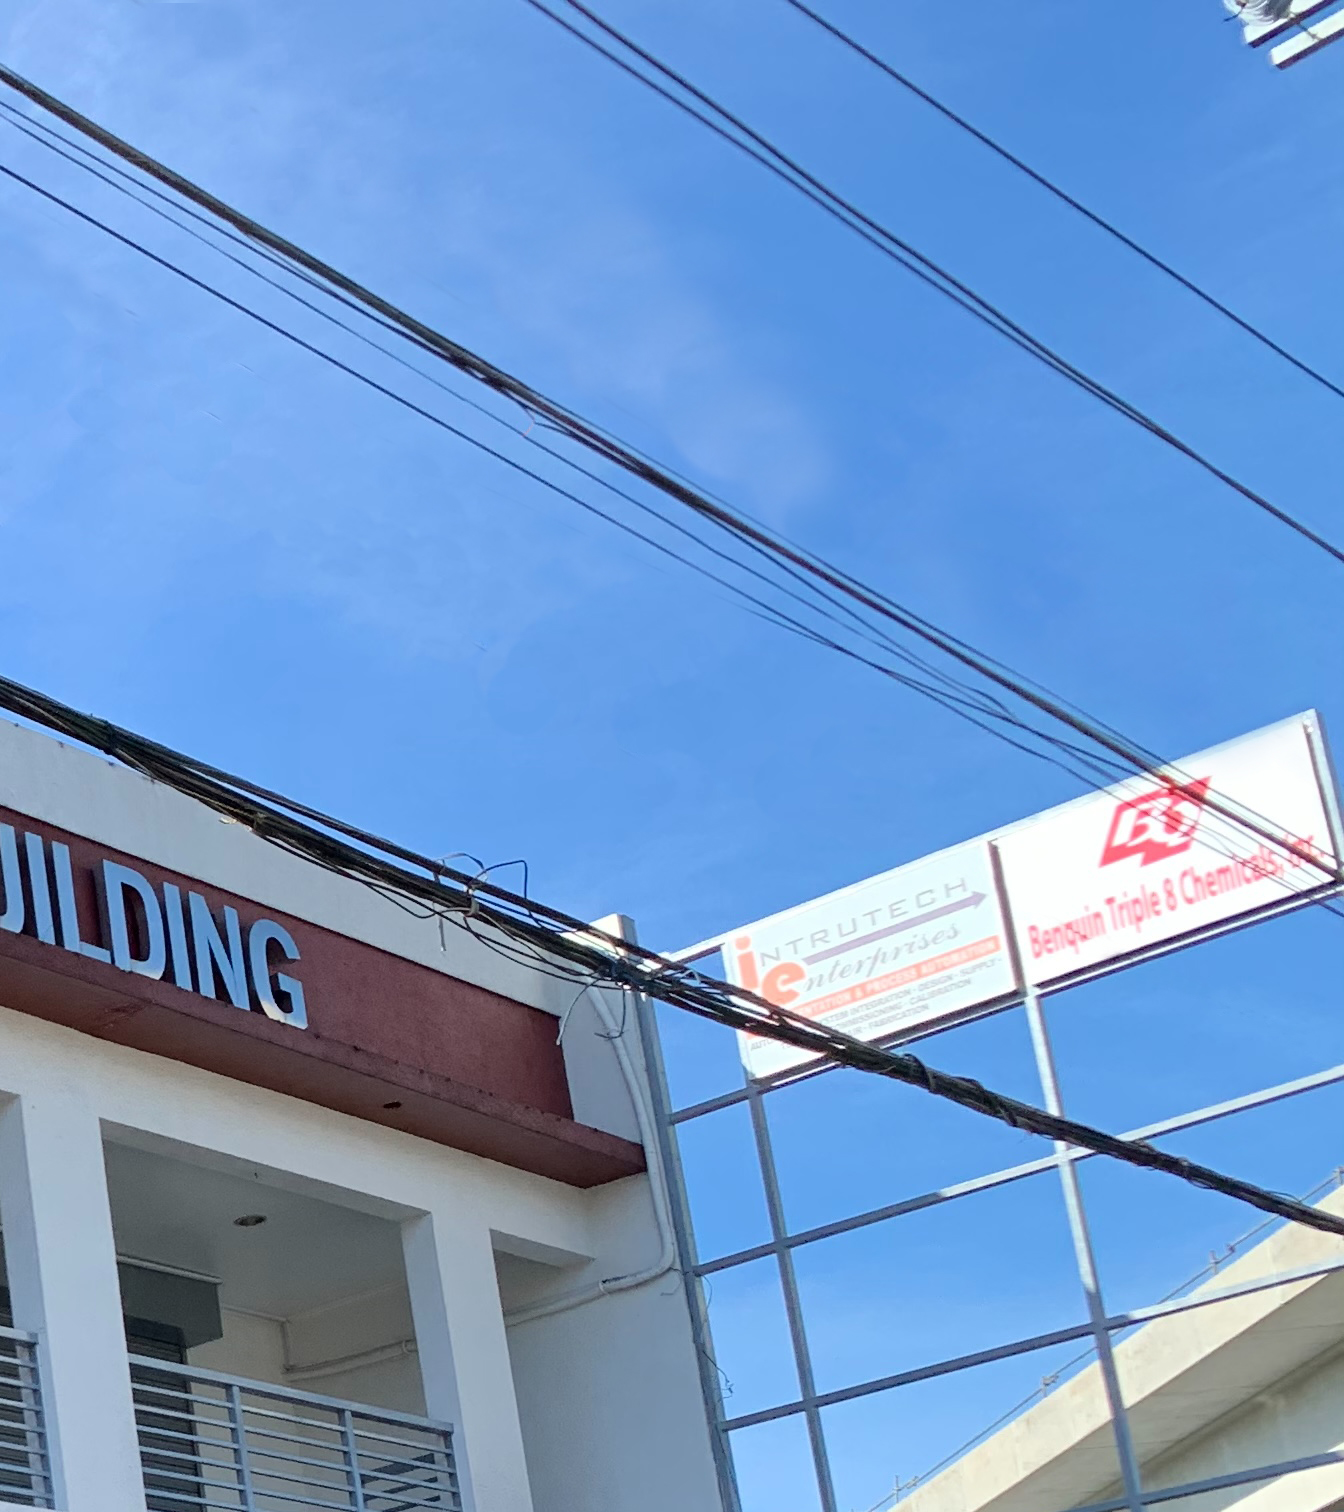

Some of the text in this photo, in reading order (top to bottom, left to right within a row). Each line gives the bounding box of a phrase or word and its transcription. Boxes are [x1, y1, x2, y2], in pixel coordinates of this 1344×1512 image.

[1028, 905, 1107, 959] Benquin
[1105, 884, 1162, 934] Triple
[1163, 877, 1178, 911] 8
